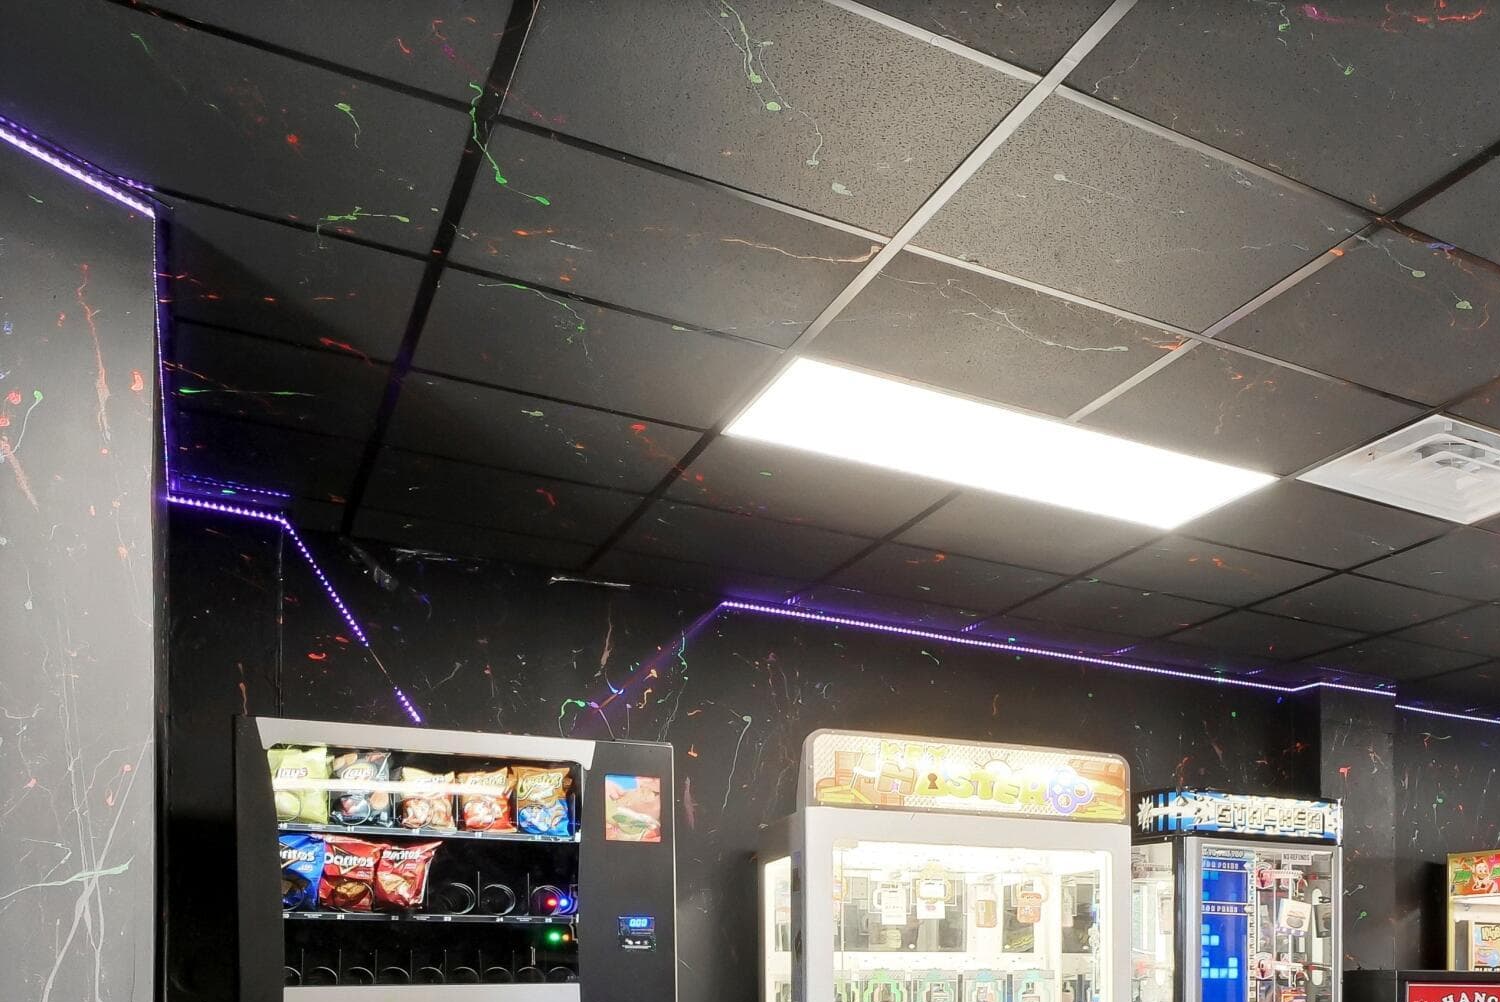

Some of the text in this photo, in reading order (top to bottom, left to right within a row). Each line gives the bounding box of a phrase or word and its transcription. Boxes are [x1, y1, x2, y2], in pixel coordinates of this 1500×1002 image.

[1215, 801, 1324, 834] STACKER
[280, 849, 315, 861] ritos
[324, 853, 374, 867] Doritos
